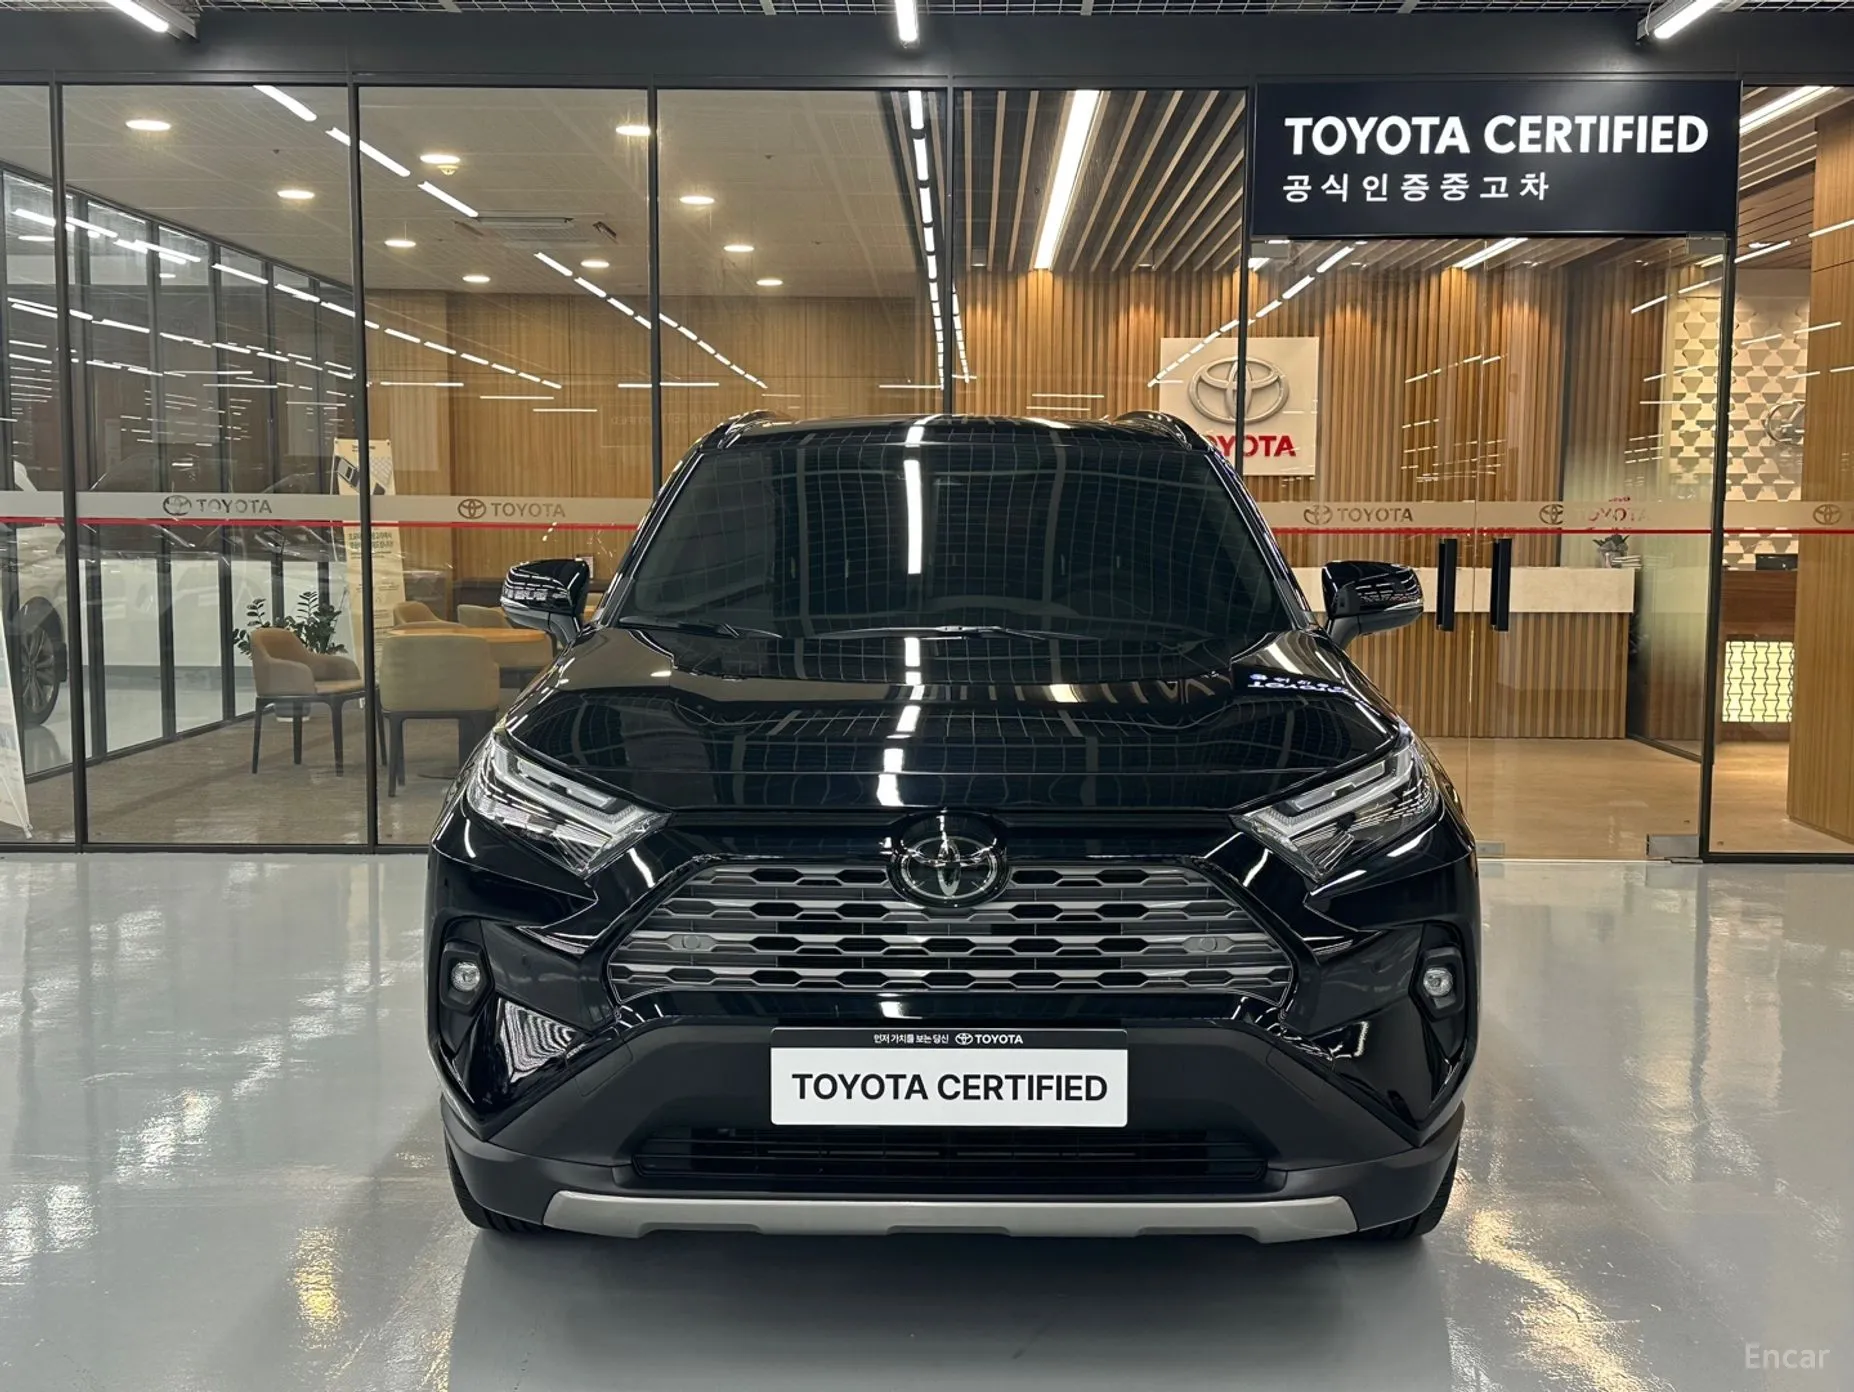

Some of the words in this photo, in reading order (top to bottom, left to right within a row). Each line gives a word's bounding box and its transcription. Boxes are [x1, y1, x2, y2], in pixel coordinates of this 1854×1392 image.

[1284, 116, 1470, 155] TOYOTA
[1484, 115, 1709, 153] CERTIFIED
[196, 498, 272, 514] TOYOTA
[490, 502, 566, 518] TOYOTA
[1337, 507, 1414, 522] TOYOTA
[873, 1033, 890, 1045] 먼저
[932, 1033, 949, 1045] 당신
[975, 1034, 1024, 1045] TOYOTA
[792, 1073, 928, 1101] TOYOTA
[937, 1073, 1108, 1102] CERTIFIED
